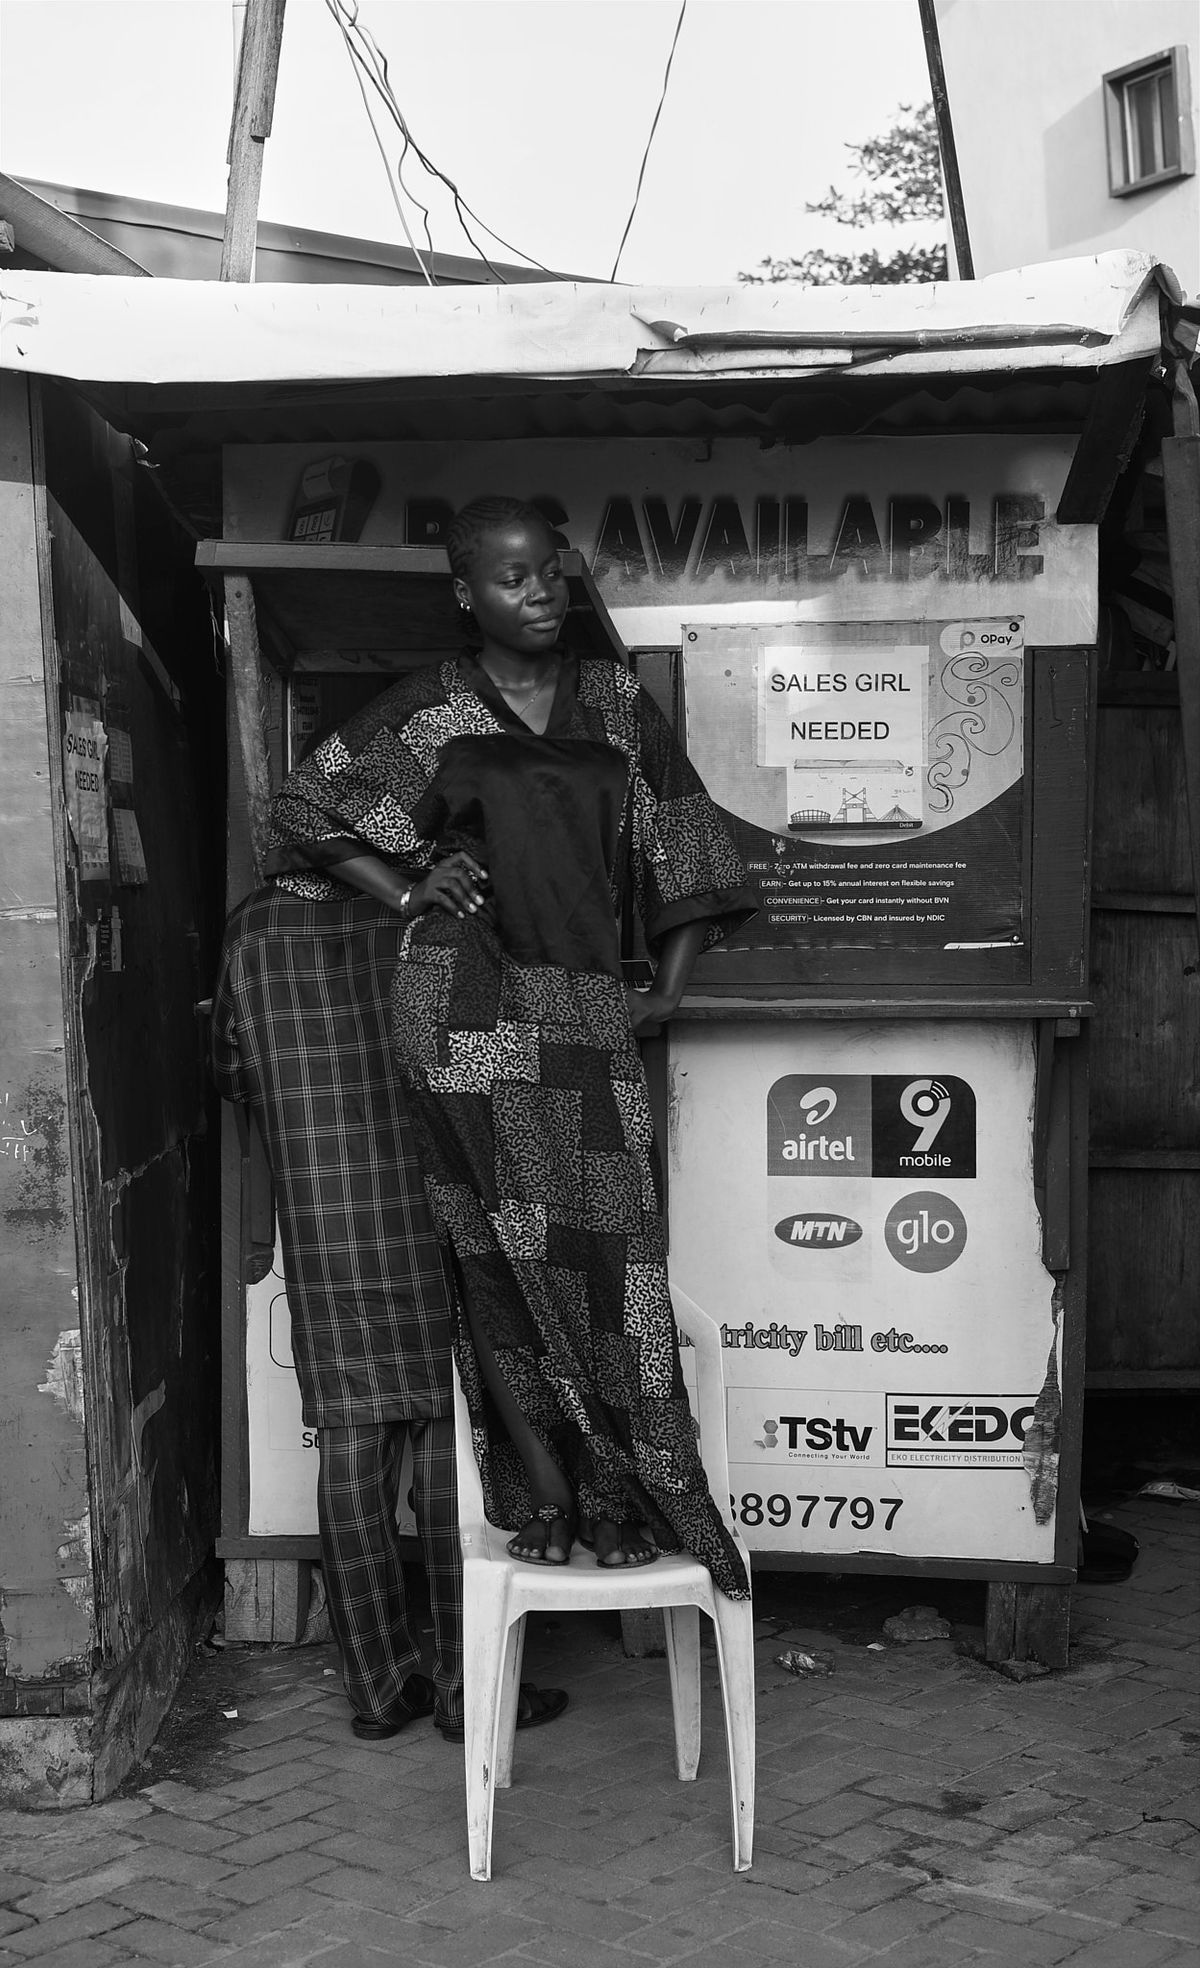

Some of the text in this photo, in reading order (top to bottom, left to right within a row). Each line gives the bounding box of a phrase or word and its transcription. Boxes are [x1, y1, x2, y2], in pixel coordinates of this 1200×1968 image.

[980, 634, 1013, 646] OPay
[770, 673, 911, 693] SALES GIRL
[791, 721, 890, 741] NEEDED
[808, 862, 846, 870] withdrawal
[802, 881, 812, 889] up
[901, 879, 927, 887] flexible
[928, 880, 955, 888] savings
[766, 897, 820, 905] CONVENIENCE
[840, 898, 857, 906] your
[875, 897, 905, 906] instantly
[813, 914, 845, 922] Licensed
[846, 914, 855, 923] by
[916, 914, 926, 922] by
[899, 1079, 952, 1152] 9
[781, 1133, 856, 1161] airtel
[899, 1153, 952, 1167] mobile
[790, 1218, 848, 1242] MTN
[896, 1210, 955, 1255] glo
[814, 1324, 863, 1351] bill
[870, 1328, 948, 1354] etc....
[779, 1416, 873, 1451] TStv
[788, 1451, 829, 1460] Connecting
[890, 1453, 1021, 1463] EKO ELECTRICITY DISTRIBUTION
[729, 1492, 904, 1531] 897797
